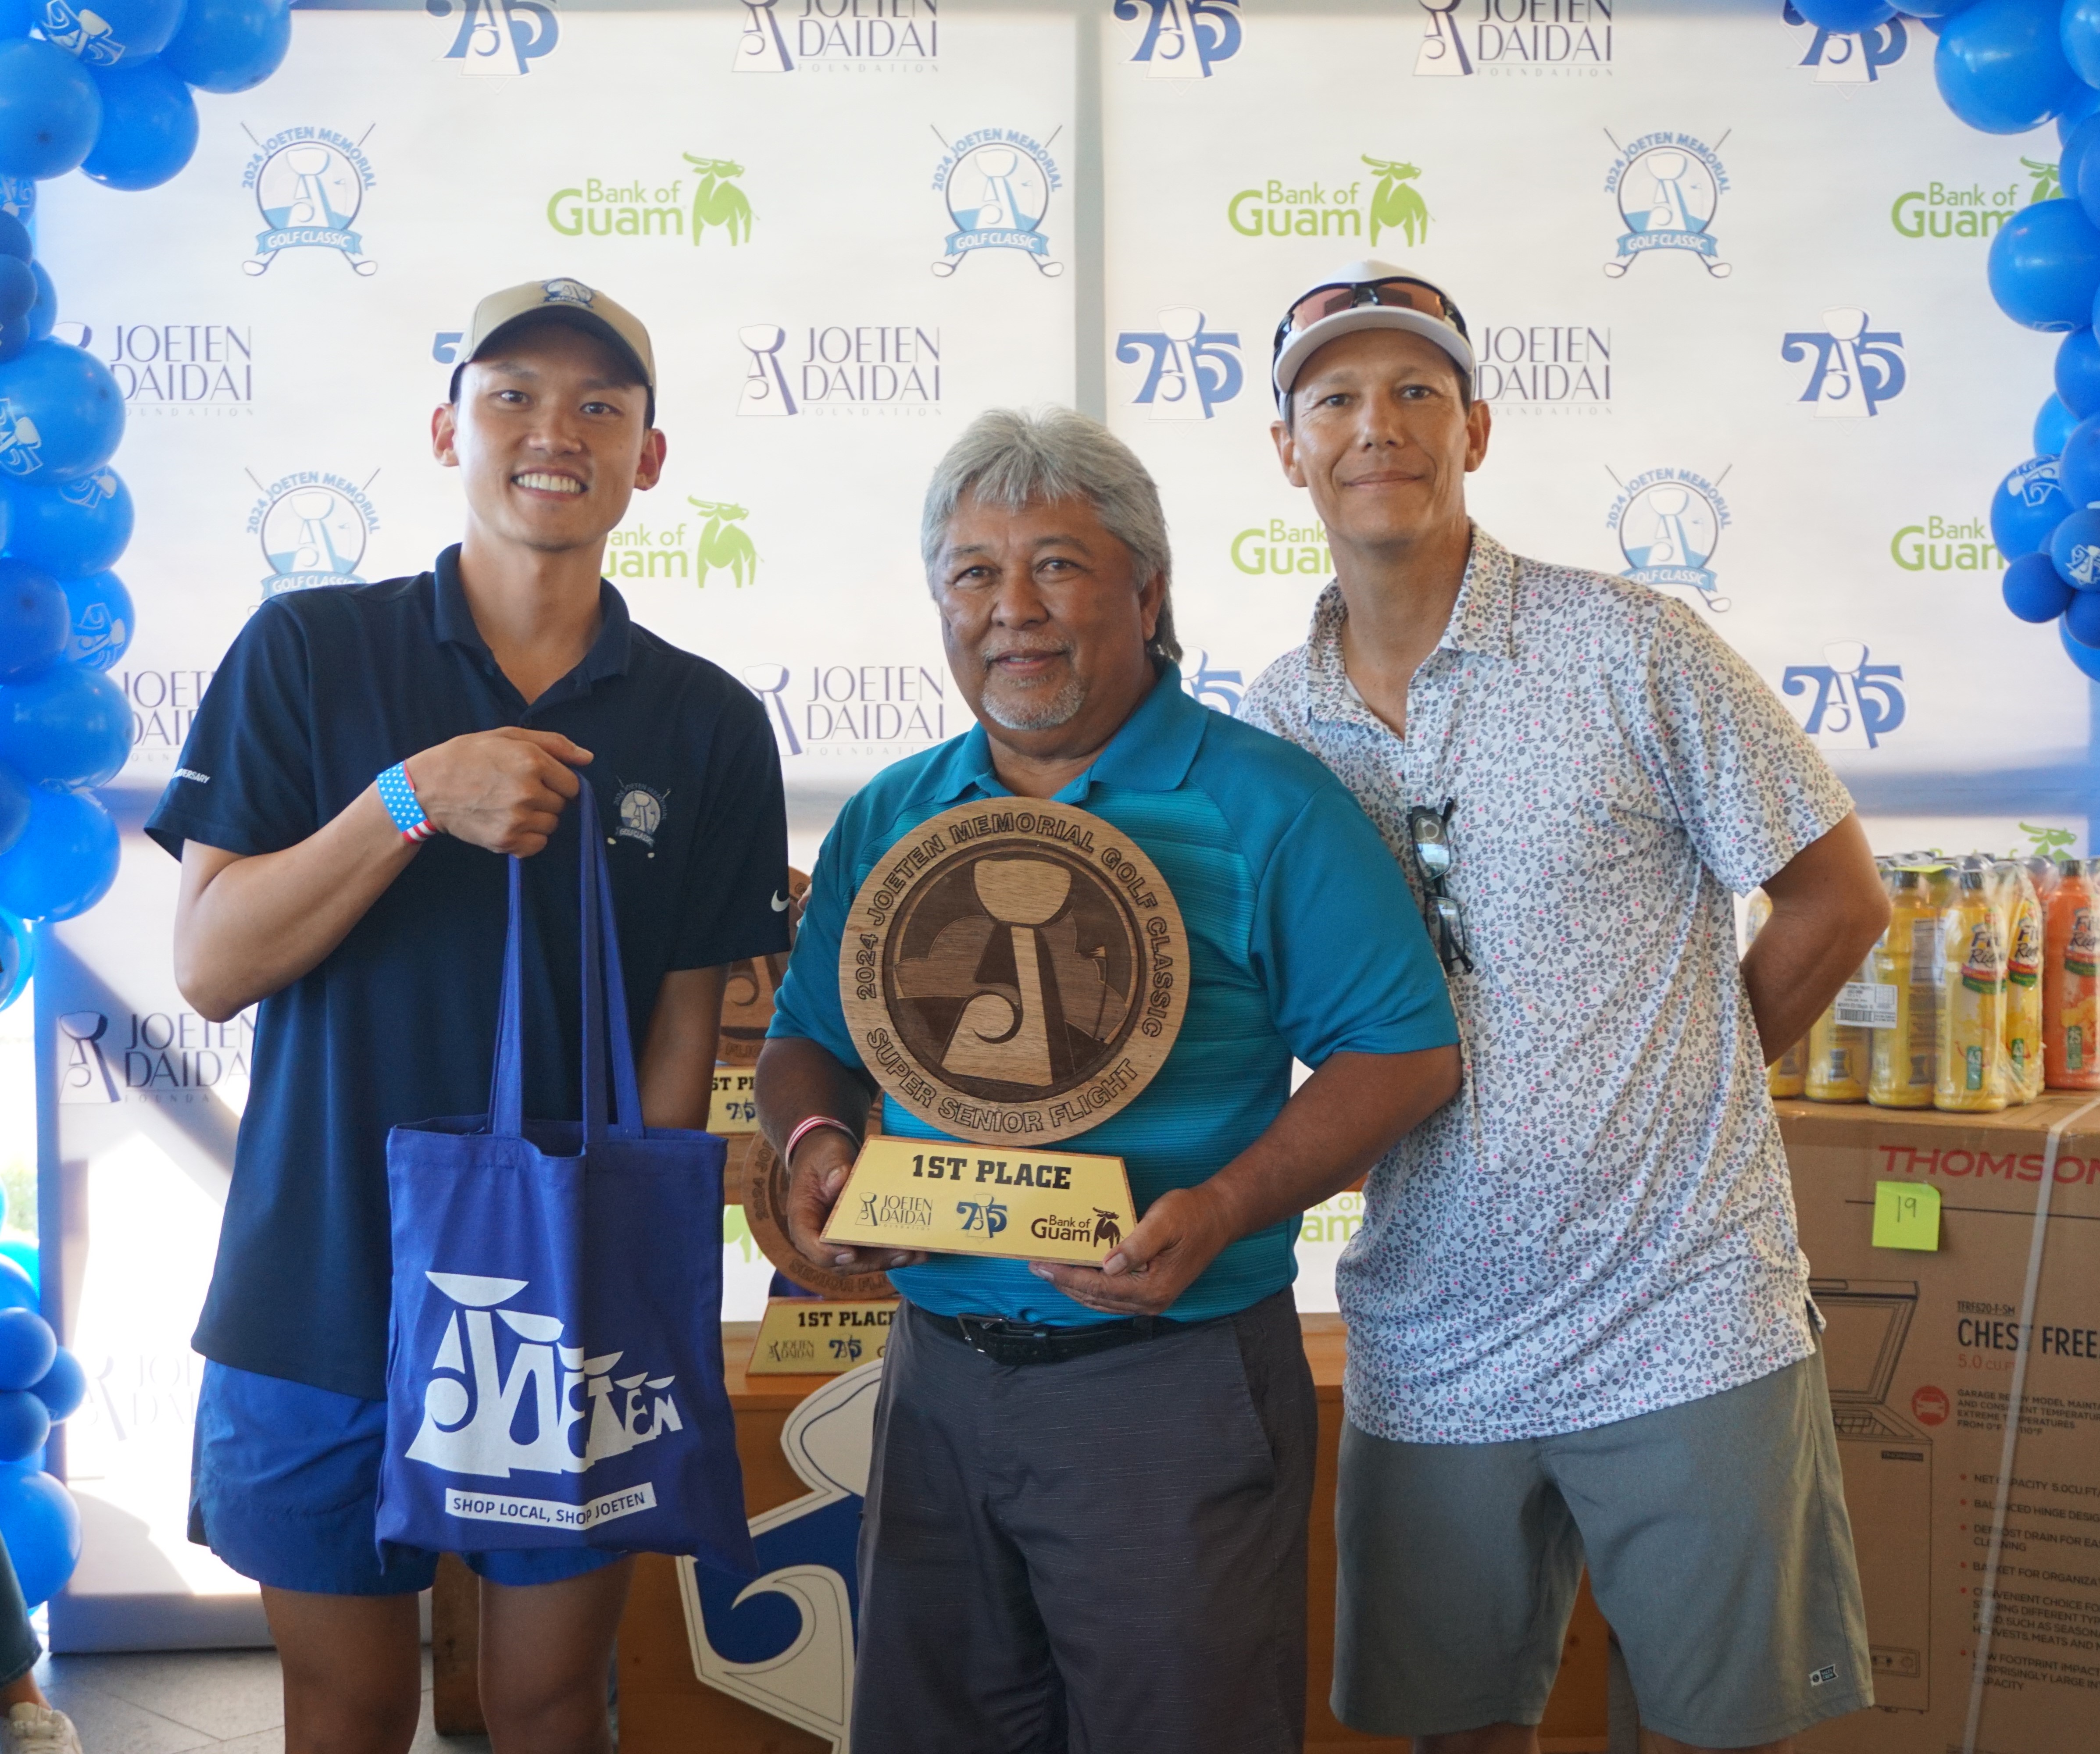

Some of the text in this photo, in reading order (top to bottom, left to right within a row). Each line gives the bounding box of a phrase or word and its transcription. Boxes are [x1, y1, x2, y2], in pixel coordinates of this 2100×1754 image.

[799, 19, 937, 57] DAIDAI
[1478, 25, 1612, 61] DAIDAI
[798, 64, 939, 72] FOUNDATION
[1477, 68, 1614, 77] FOUNDATION
[242, 126, 376, 190] 2024 JOETEN MEMORIAL
[932, 128, 1063, 192] 2024 JOETEN MEMORIAL
[1604, 132, 1731, 195] 2024 JOETEN MEMORIAL
[587, 178, 682, 203] Bank of
[1267, 180, 1360, 204] Bank of
[1929, 182, 2019, 206] Bank of
[547, 189, 683, 236] Guam
[1228, 190, 1361, 236] Guam
[267, 231, 351, 248] GOLF CLASSIC
[956, 232, 1038, 249] GOLF CLASSIC
[1628, 234, 1707, 250] GOLF CLASSIC
[110, 324, 252, 362] JOETEN
[803, 327, 940, 363] JOETEN
[1479, 326, 1611, 363] JOETEN
[802, 364, 940, 401] DAIDAI
[1479, 364, 1611, 400] DAIDAI
[126, 407, 253, 416] OUNDATION
[802, 407, 942, 416] FOUNDATION
[1491, 407, 1613, 416] OUNDATION
[246, 471, 380, 534] 2024 JOETEN MEMORIAL
[1607, 467, 1732, 530] 2024 JOETEN MEMORIAL
[607, 524, 687, 545] ank of
[1270, 519, 1327, 542] Bank
[1929, 516, 1986, 539] Bank
[1231, 528, 1332, 574] Gua
[601, 550, 688, 577] uam
[272, 575, 306, 592] GOLF
[1659, 570, 1707, 585] CLASSIC
[807, 666, 944, 702] JOETEN
[807, 703, 944, 740] DAIDAI
[856, 812, 1173, 1038] 2024 JOETEN MEMORIAL GOLF CLASSIC
[125, 1050, 251, 1087] DAIDA
[867, 1027, 1138, 1133] SUPER SENIOR FLIGHT
[711, 1077, 731, 1091] ST
[913, 1155, 1071, 1190] 1ST PLACE
[882, 1195, 933, 1212] JOETEN
[1897, 1196, 1916, 1223] 19
[880, 1208, 933, 1226] DAIDAI
[1049, 1215, 1091, 1229] Bank of
[1031, 1219, 1091, 1242] Guam
[799, 1312, 832, 1327] 1ST
[2042, 1326, 2100, 1359] FREE
[1957, 1389, 1995, 1400] GARAGE
[2032, 1397, 2065, 1408] MODEL
[1957, 1400, 1978, 1408] AND
[1957, 1409, 2000, 1421] EXTREME
[1957, 1420, 1984, 1429] FROM
[1975, 1475, 1994, 1483] NET
[454, 1491, 645, 1525] SHOP LOCAL, SHOP JOETEN
[2034, 1506, 2066, 1519] HINGE
[2025, 1530, 2058, 1543] DRAIN
[2060, 1535, 2082, 1545] FOR
[2018, 1568, 2039, 1578] FOR
[2042, 1571, 2100, 1586] ORGANIZA
[2021, 1606, 2078, 1622] DIFFERENT
[2043, 1597, 2083, 1610] CHOICE
[2006, 1617, 2035, 1629] SUCH
[2037, 1622, 2052, 1631] AS
[2070, 1639, 2094, 1650] AND
[2000, 1653, 2058, 1670] FOOTPRINT
[2050, 1674, 2085, 1687] LARGE
